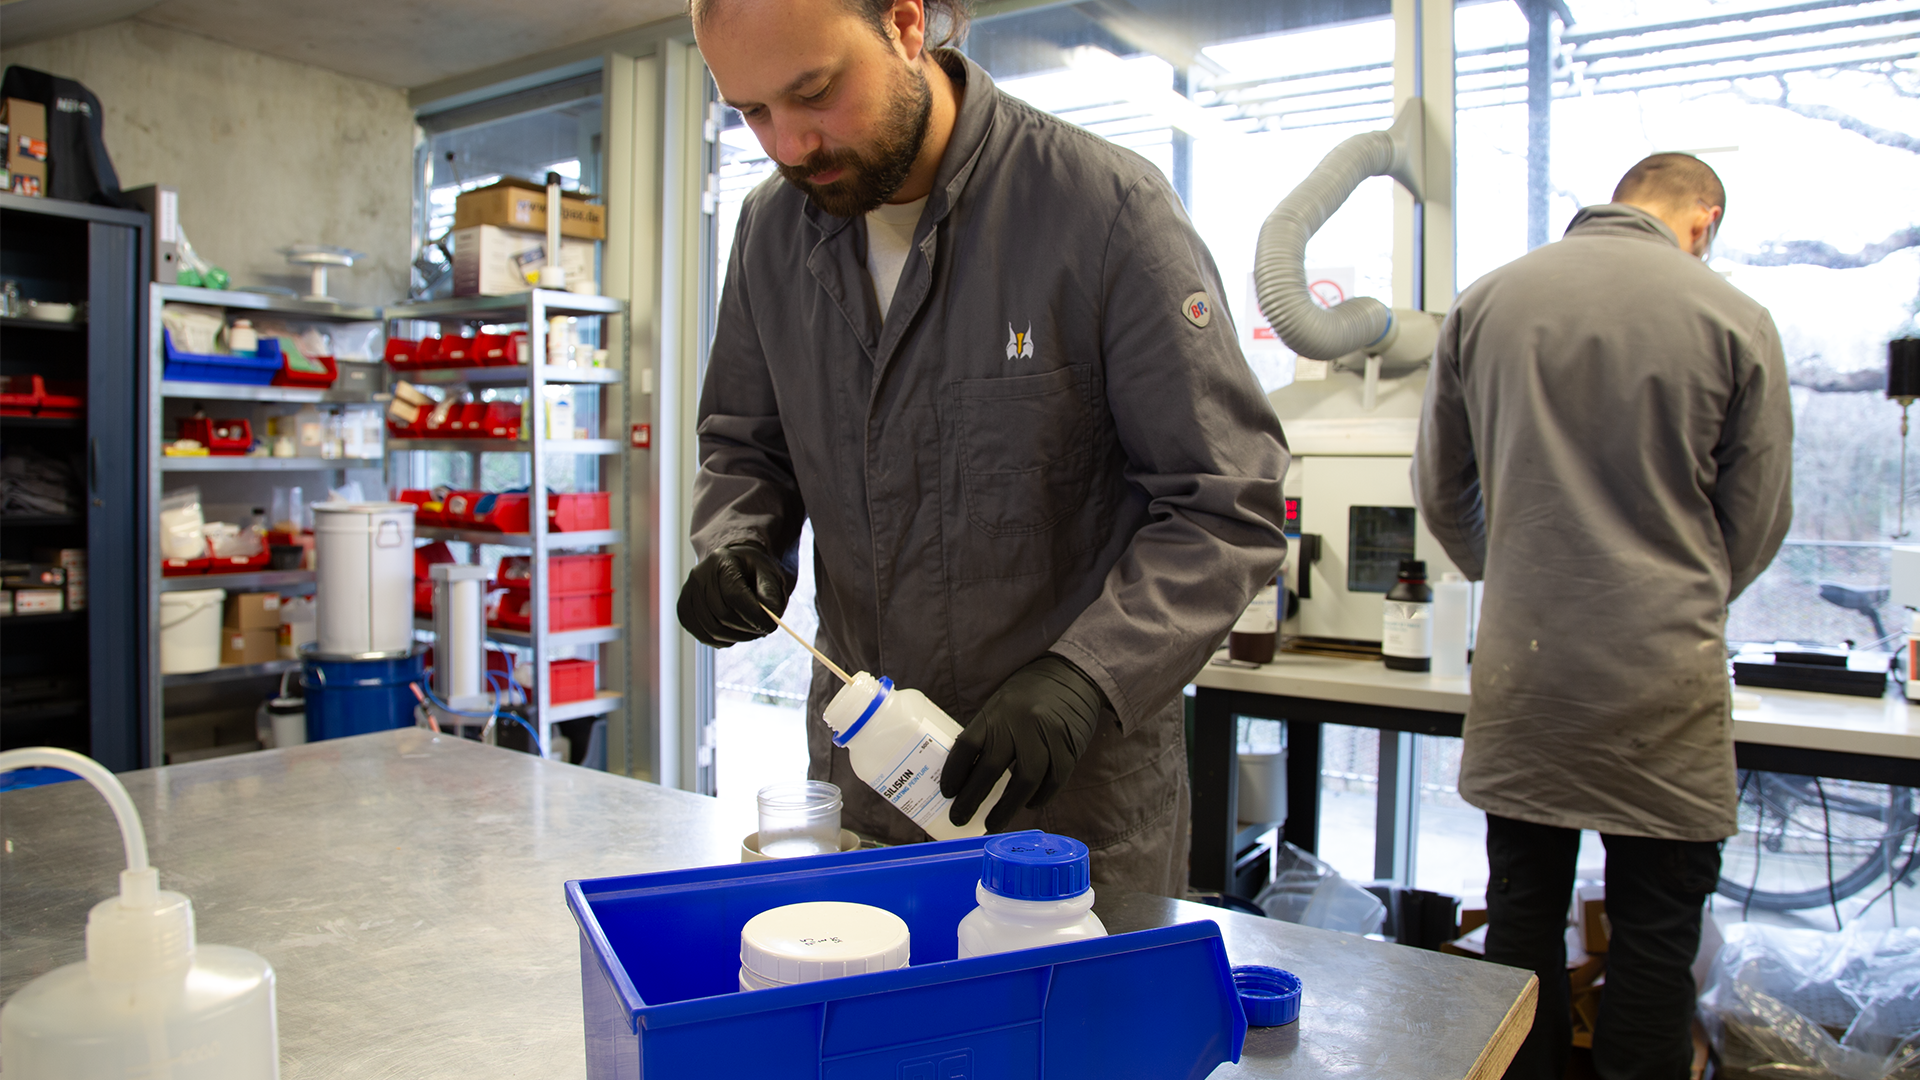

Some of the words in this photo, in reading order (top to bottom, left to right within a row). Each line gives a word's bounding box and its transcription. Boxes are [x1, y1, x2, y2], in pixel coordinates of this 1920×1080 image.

[884, 769, 914, 798] SILISKIN
[891, 786, 910, 803] COATING
[908, 765, 929, 787] PEINTURE
